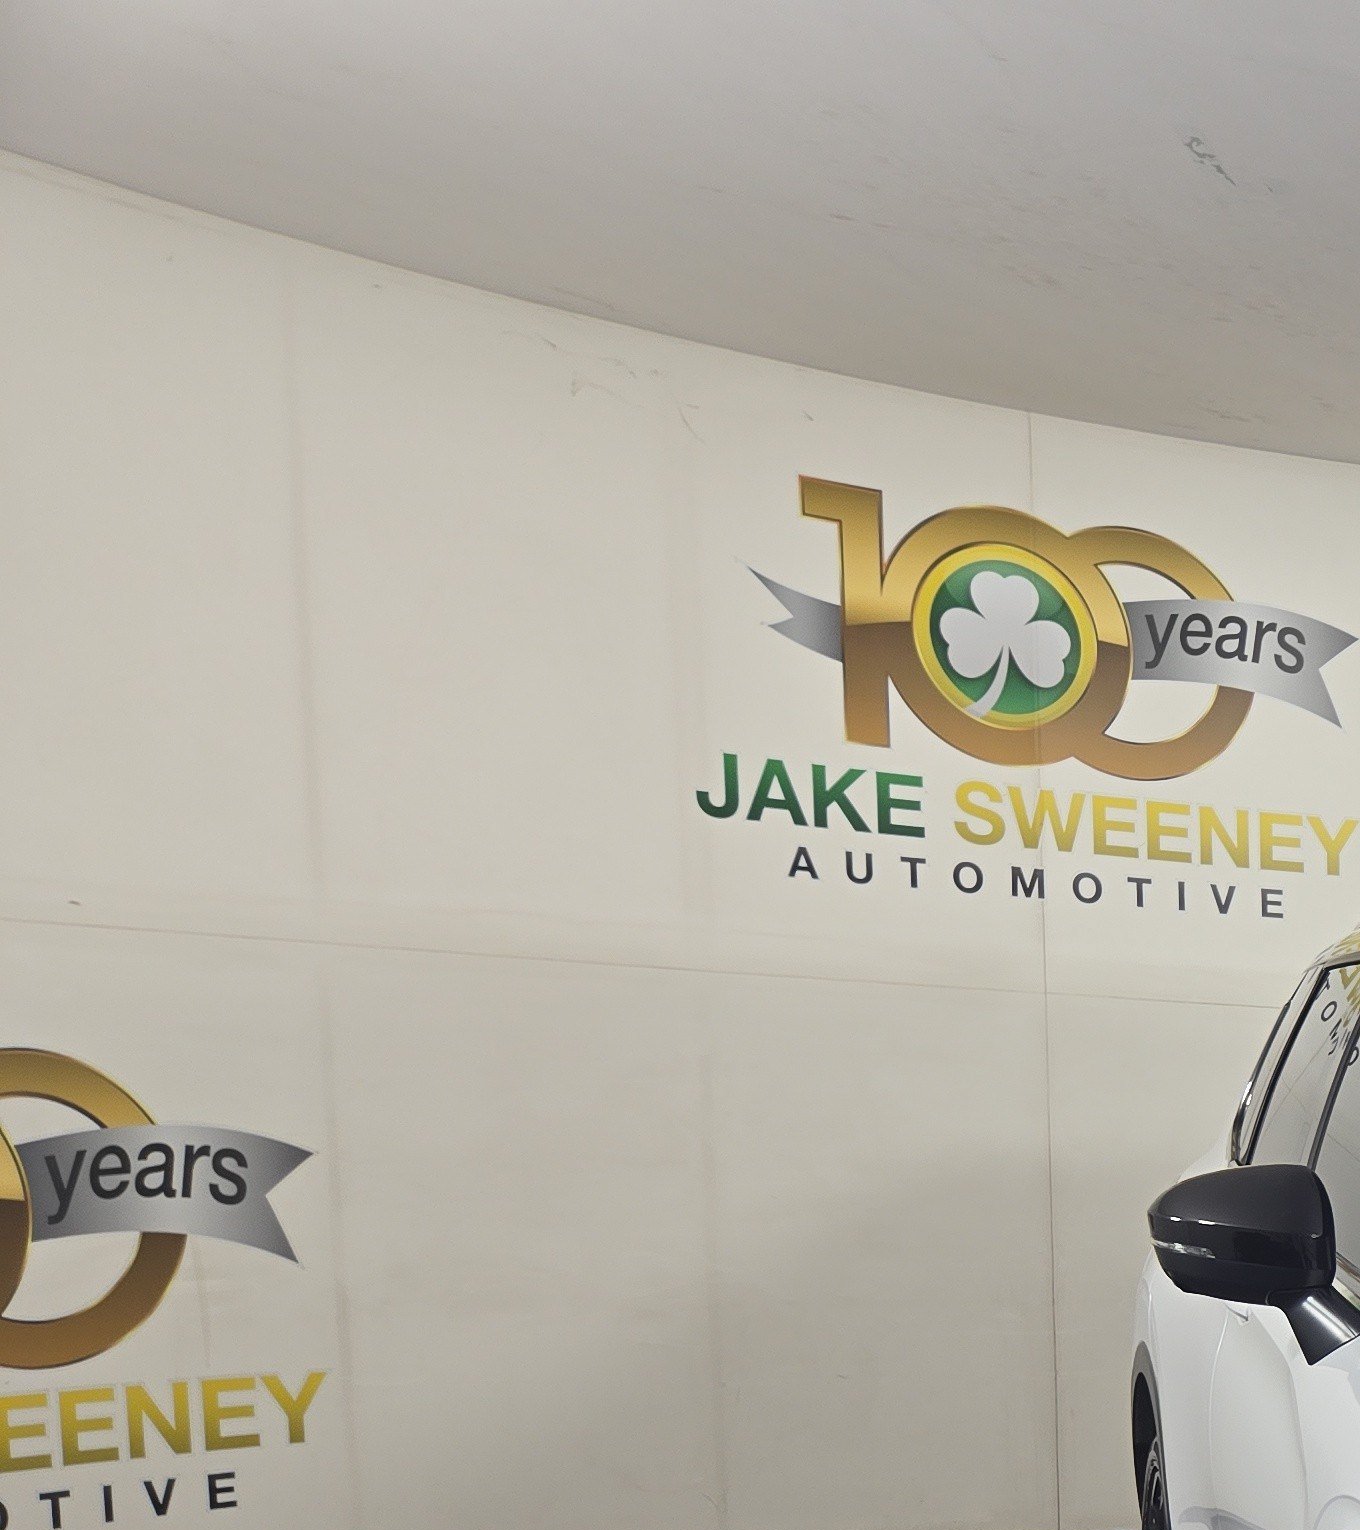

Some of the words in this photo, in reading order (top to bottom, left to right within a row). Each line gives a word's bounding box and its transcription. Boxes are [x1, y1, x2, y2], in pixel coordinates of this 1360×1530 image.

[798, 474, 1255, 780] 100
[1144, 611, 1306, 674] years
[696, 752, 926, 839] JAKE
[953, 780, 1358, 876] SWEENEY
[788, 847, 1285, 919] AUTOMOTIVE
[45, 1139, 249, 1225] years
[0, 1371, 328, 1473] EENEY
